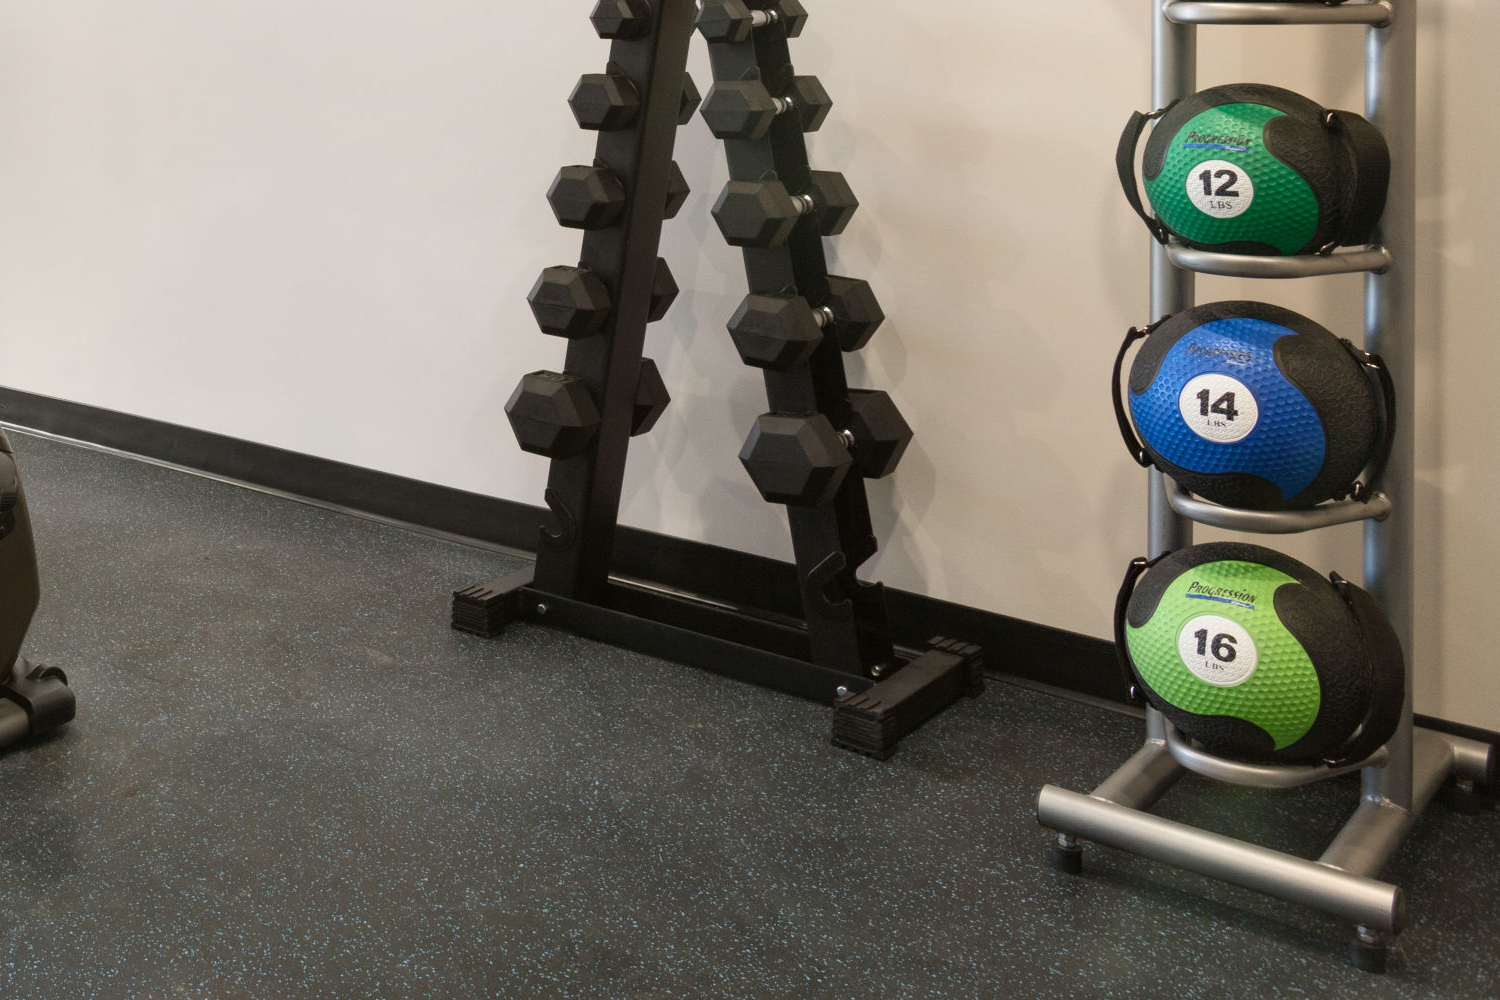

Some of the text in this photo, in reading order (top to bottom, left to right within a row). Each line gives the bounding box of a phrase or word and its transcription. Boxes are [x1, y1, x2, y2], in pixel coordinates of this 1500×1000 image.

[1199, 169, 1239, 197] 12
[1210, 200, 1233, 210] LBS
[1196, 388, 1239, 421] 14
[1194, 628, 1238, 663] 16
[1205, 661, 1225, 672] LBS
